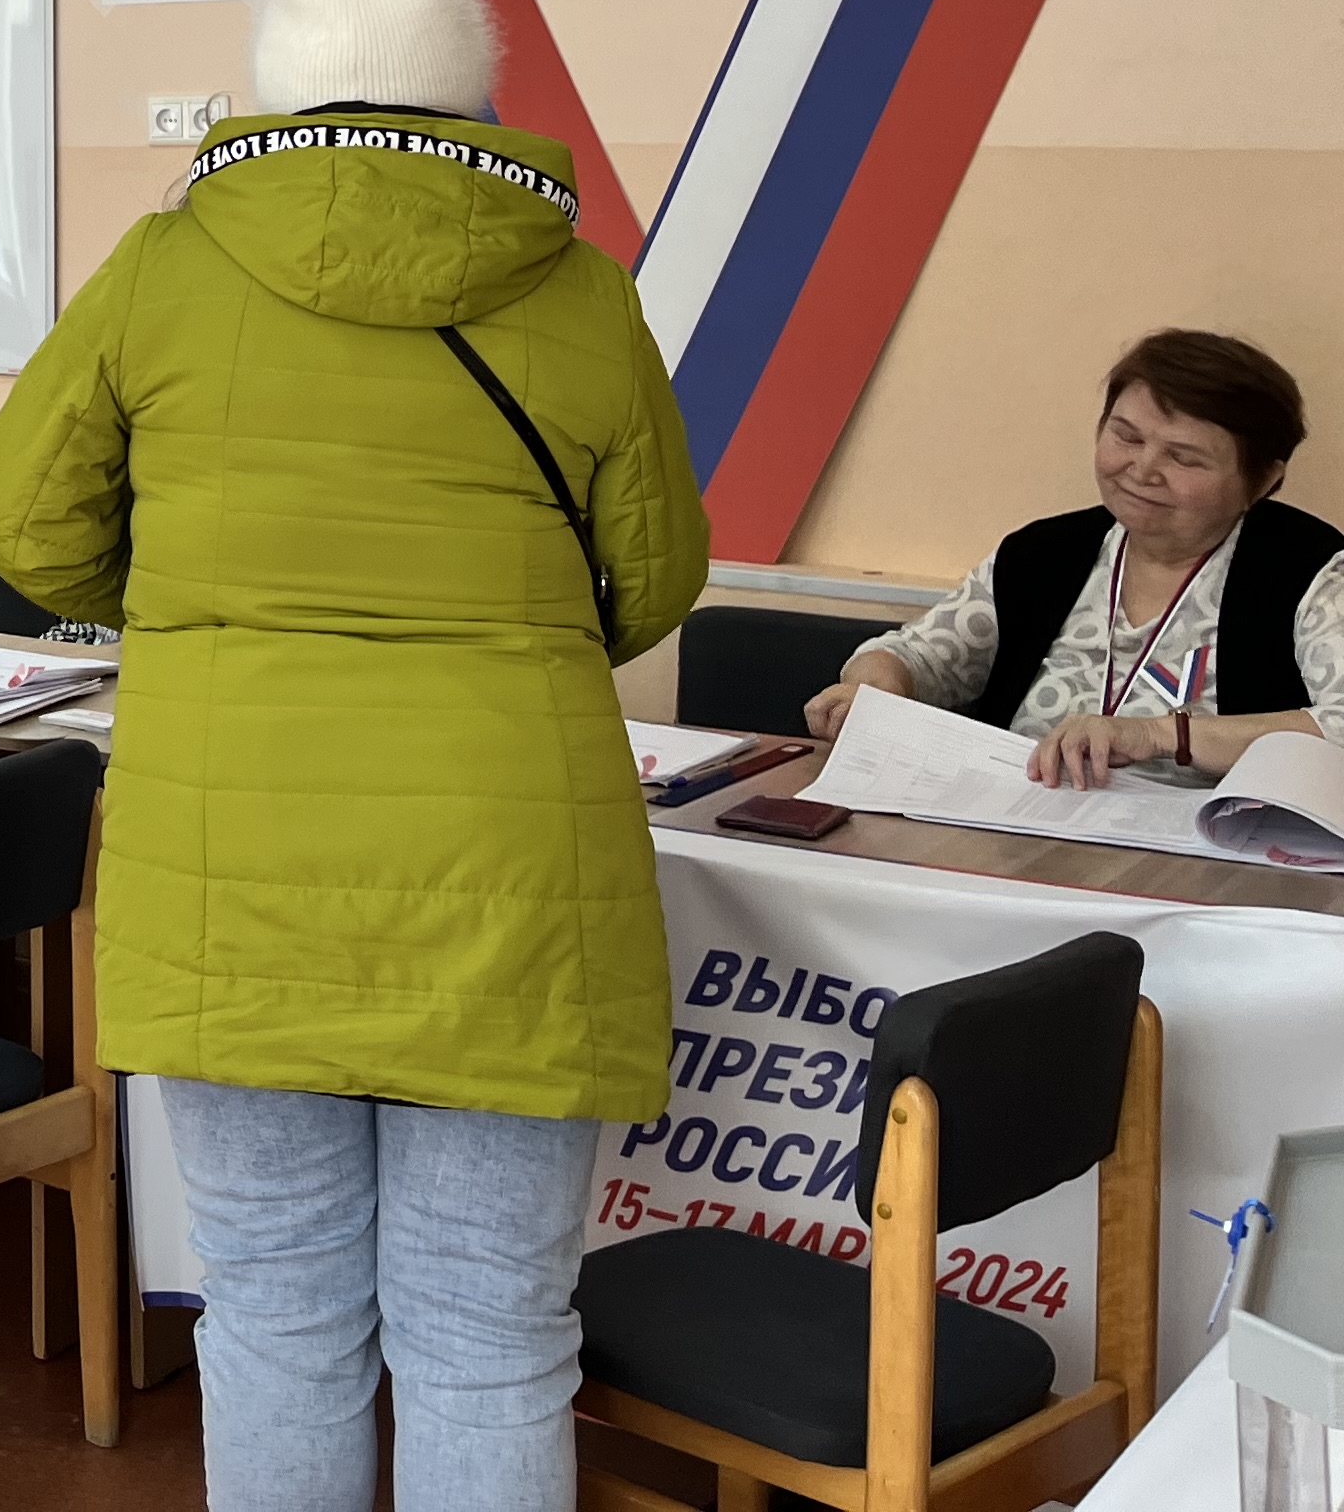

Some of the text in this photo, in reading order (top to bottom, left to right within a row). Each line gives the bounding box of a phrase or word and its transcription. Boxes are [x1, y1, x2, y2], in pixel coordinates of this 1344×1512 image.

[212, 135, 261, 170] LOVE
[267, 127, 327, 152] LOVE
[334, 128, 399, 149] LOVE
[408, 135, 470, 164] LOVE
[476, 152, 535, 189] LOVE
[685, 949, 899, 1038] ВЫБО
[620, 1112, 859, 1201] РОССИ
[936, 1248, 1069, 1318] 2024
